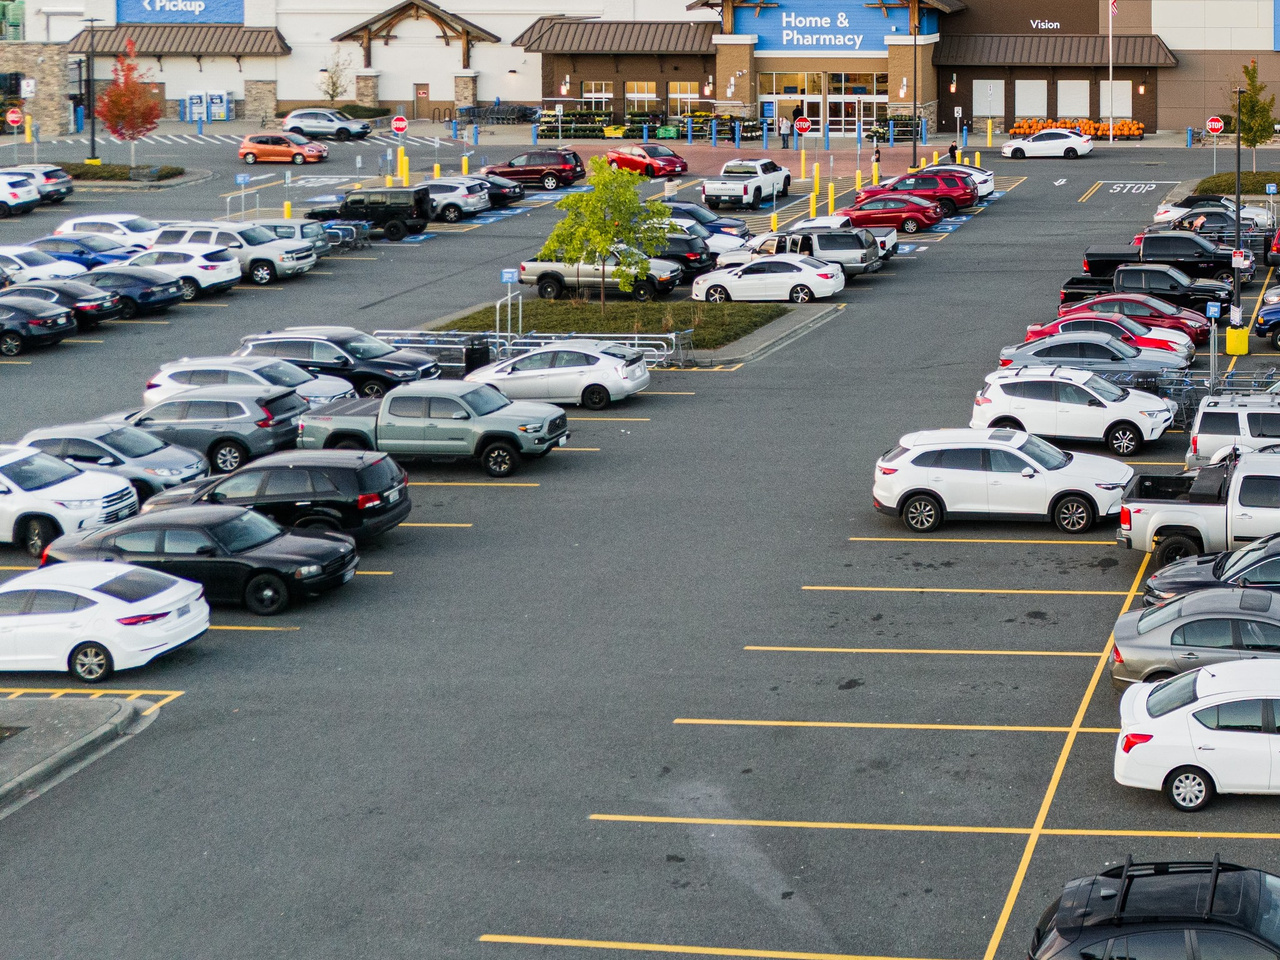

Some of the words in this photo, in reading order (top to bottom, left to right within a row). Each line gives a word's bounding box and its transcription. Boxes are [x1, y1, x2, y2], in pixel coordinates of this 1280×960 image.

[782, 12, 831, 27] Home
[837, 12, 849, 27] &
[1030, 19, 1060, 29] Vision
[782, 30, 863, 50] Pharmacy
[1207, 121, 1223, 129] STOP
[1109, 184, 1156, 193] STOP
